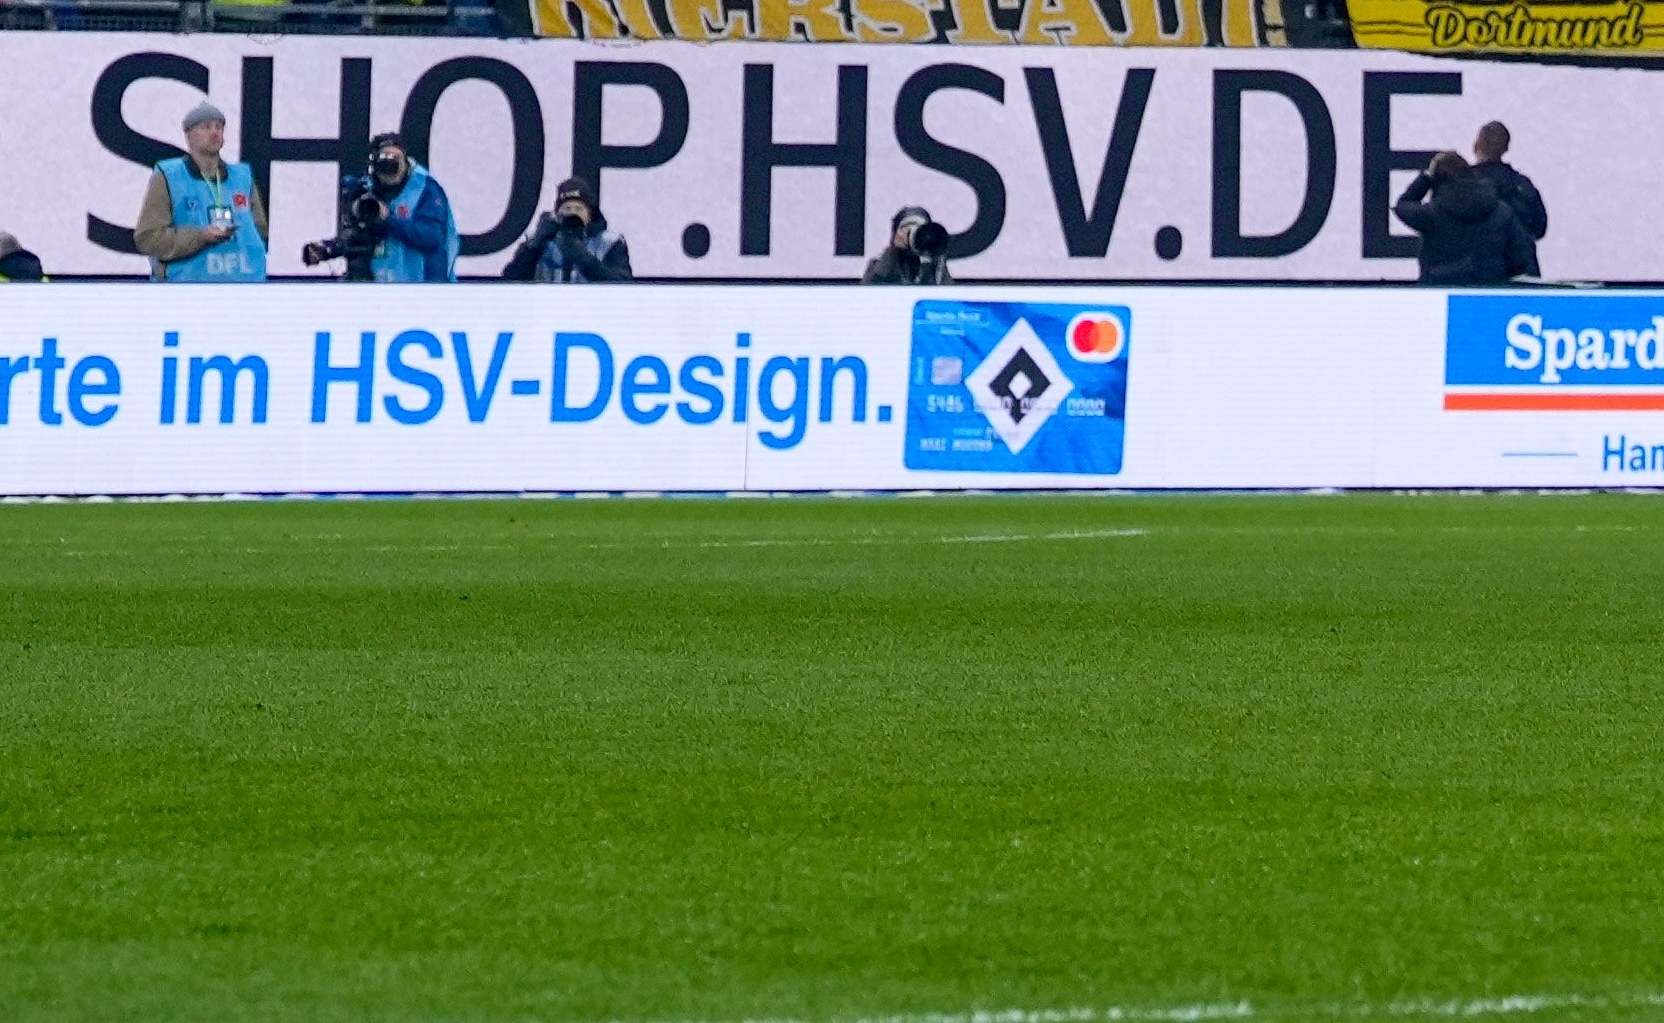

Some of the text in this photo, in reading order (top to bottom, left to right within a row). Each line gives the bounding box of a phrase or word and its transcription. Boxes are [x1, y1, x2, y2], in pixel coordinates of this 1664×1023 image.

[1425, 0, 1645, 48] Dortmund
[86, 50, 1463, 260] SHOP.HSV.DE
[206, 252, 251, 275] DFL
[159, 331, 270, 425] im
[310, 331, 894, 450] HSV-Design.
